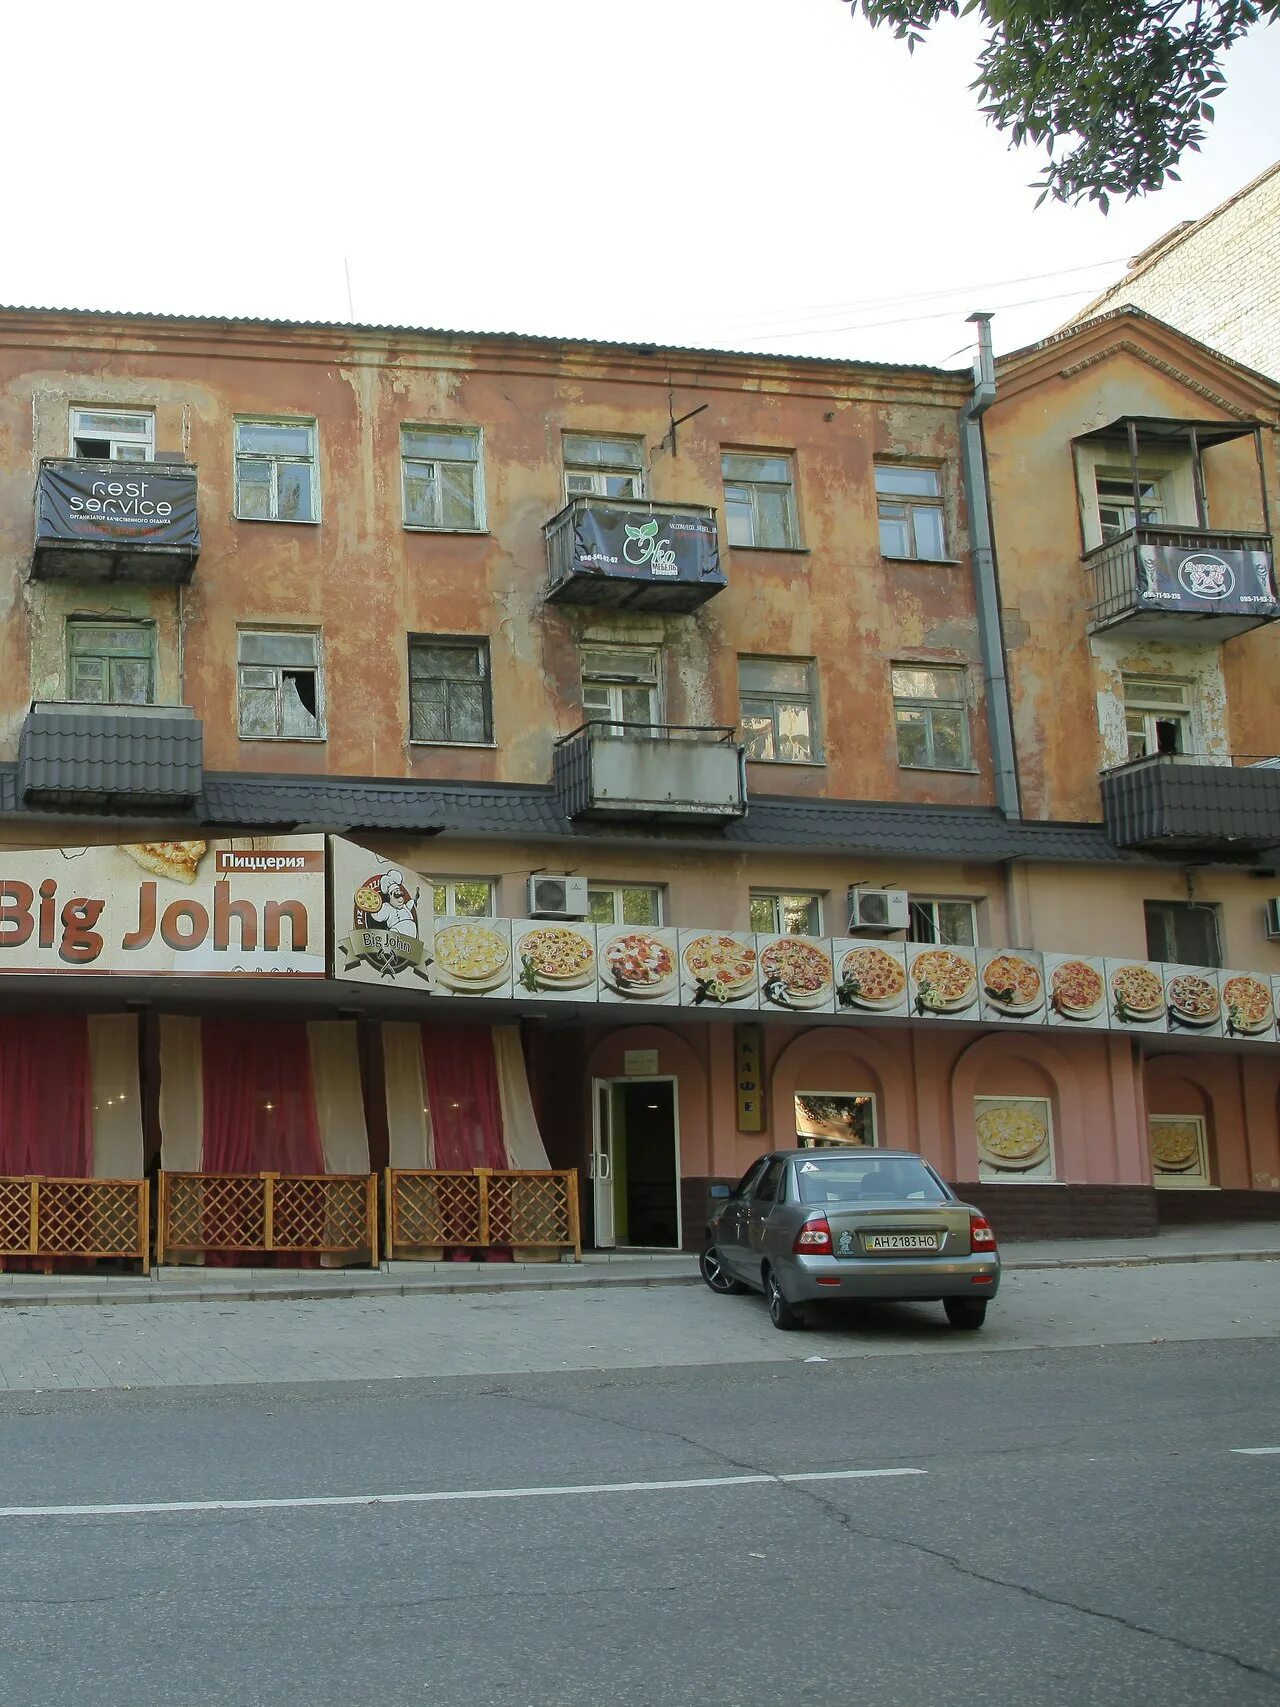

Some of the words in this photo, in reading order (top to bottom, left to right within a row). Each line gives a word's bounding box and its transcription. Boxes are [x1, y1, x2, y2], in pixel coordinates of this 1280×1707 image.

[69, 496, 172, 516] service
[653, 564, 677, 572] МЕБЕЛЬ
[221, 853, 305, 870] Пиццерия
[122, 880, 308, 953] John
[362, 932, 382, 948] Big
[384, 934, 411, 953] John
[740, 1043, 756, 1112] КАФЕ
[874, 1237, 890, 1248] AH
[892, 1236, 917, 1247] 2183
[919, 1236, 935, 1247] HO
